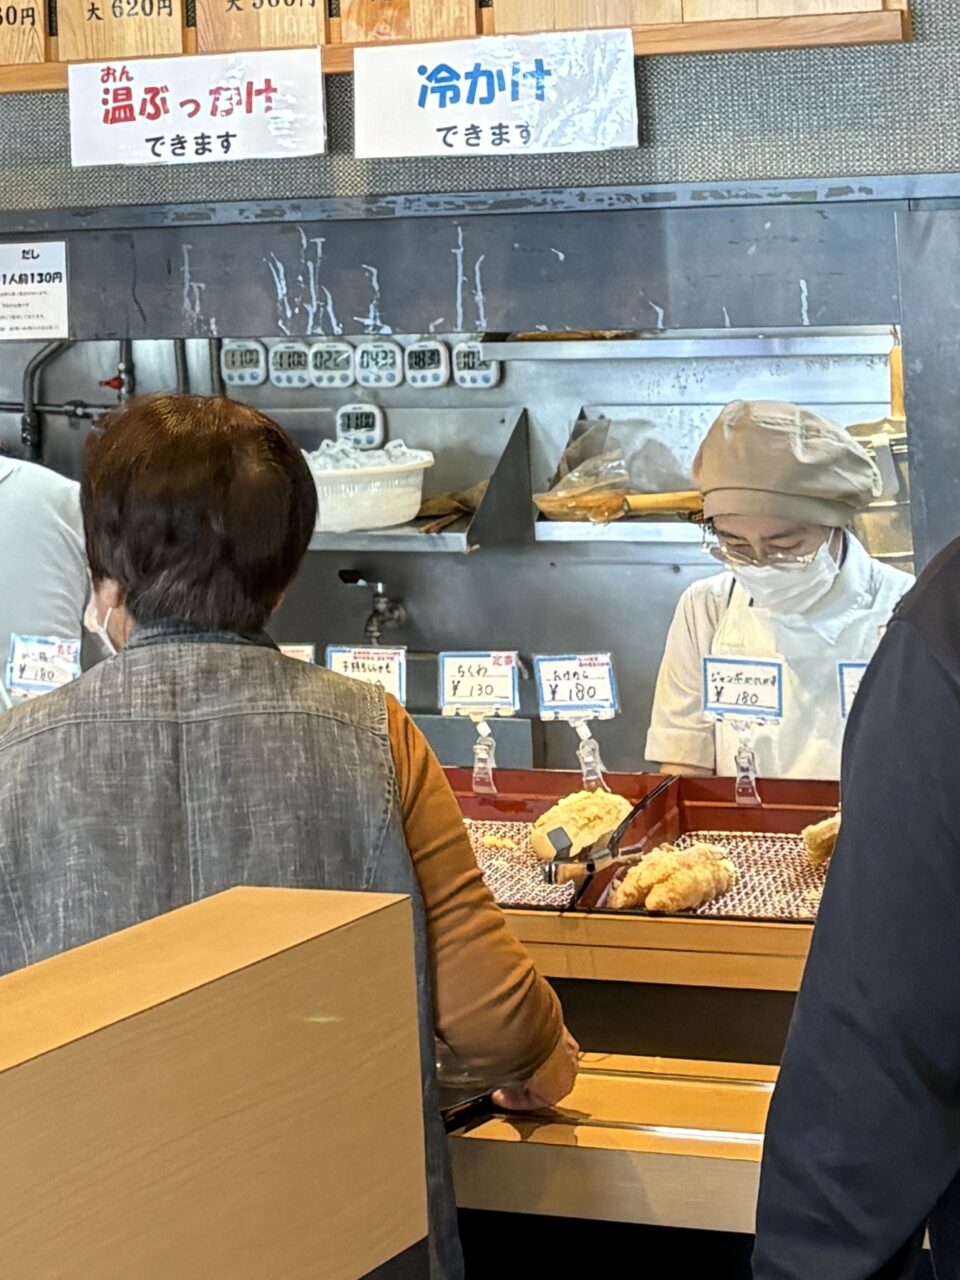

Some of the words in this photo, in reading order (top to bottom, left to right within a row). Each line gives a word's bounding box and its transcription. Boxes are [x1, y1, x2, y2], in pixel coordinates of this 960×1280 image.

[86, 1, 104, 21] 大
[101, 65, 134, 83] おん
[417, 58, 552, 109] 冷かけ
[101, 79, 278, 125] 温ぶっかけ
[145, 131, 237, 158] できます
[436, 121, 534, 148] できます
[21, 249, 40, 260] だし
[457, 665, 488, 677] ちくわ
